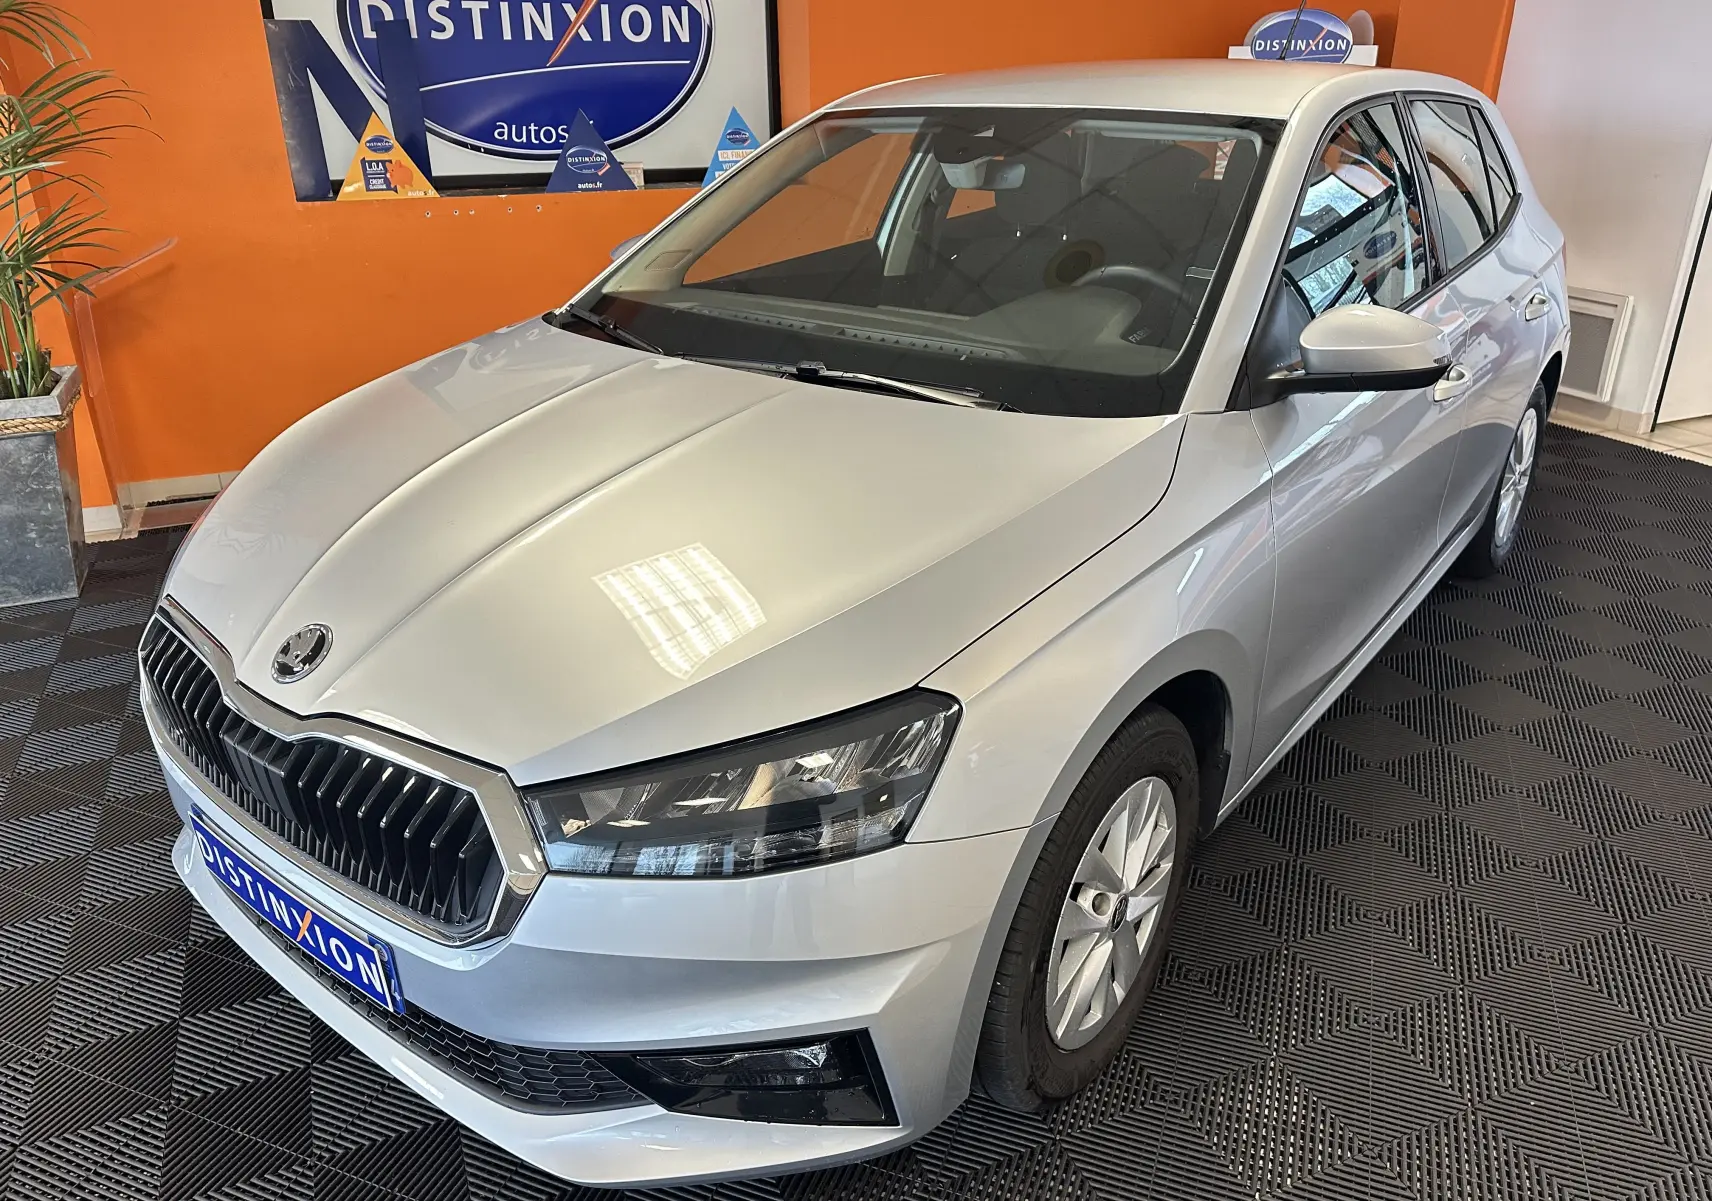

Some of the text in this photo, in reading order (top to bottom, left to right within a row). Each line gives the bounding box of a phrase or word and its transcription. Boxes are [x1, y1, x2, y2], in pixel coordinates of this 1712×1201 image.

[358, 0, 691, 43] DISTINXION
[1256, 38, 1347, 51] DISTINXION
[577, 181, 603, 189] autos.fr
[407, 189, 436, 197] autos.fr
[196, 830, 384, 995] DISTINXION
